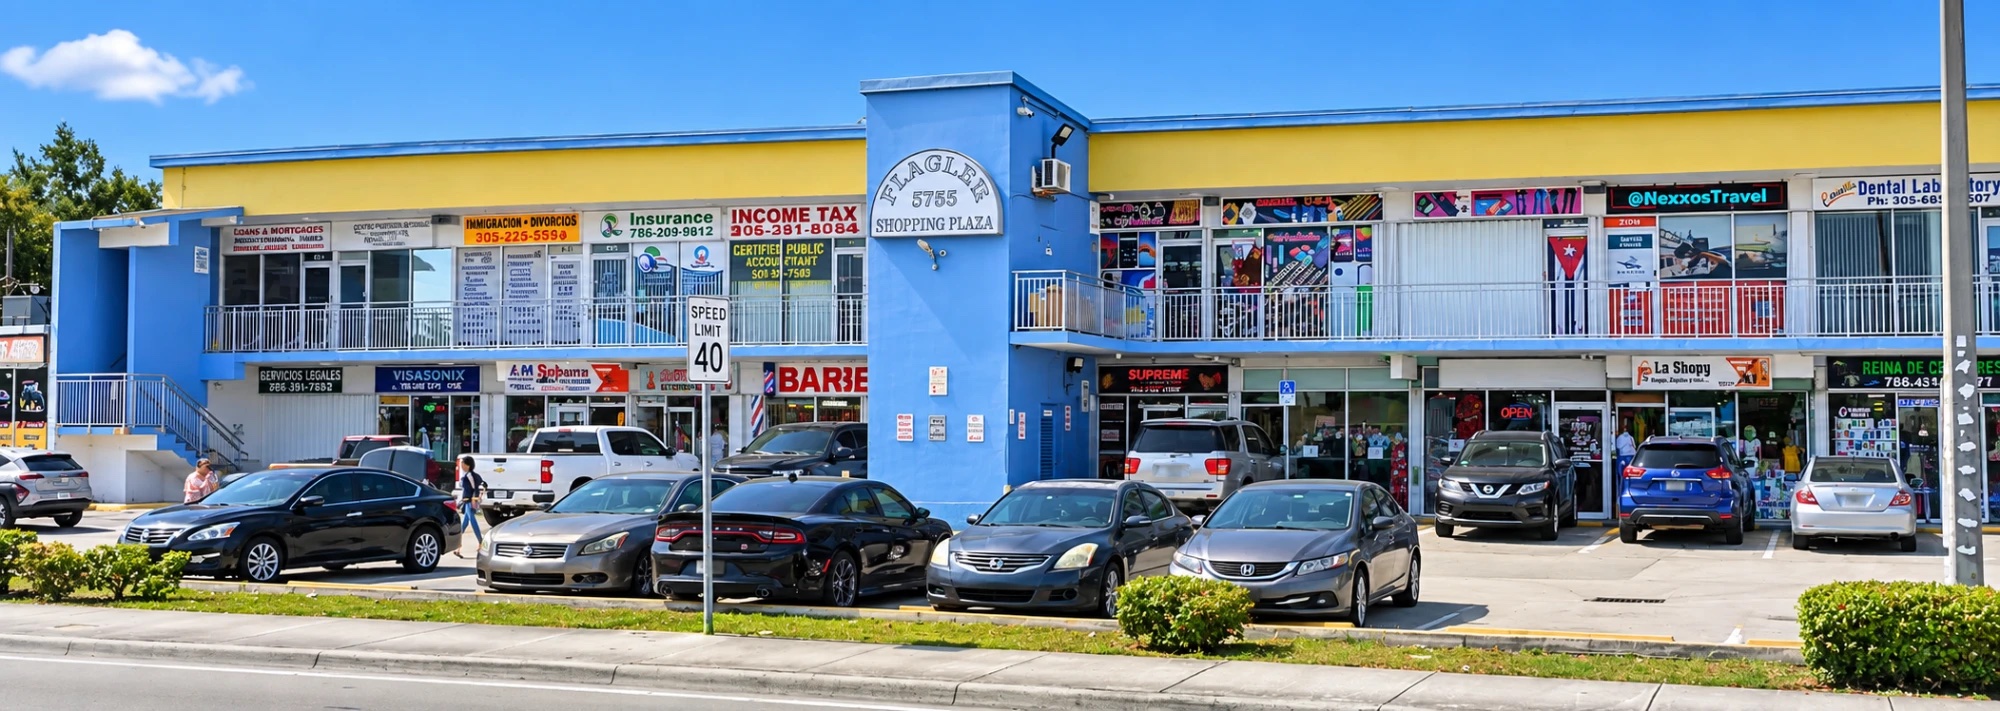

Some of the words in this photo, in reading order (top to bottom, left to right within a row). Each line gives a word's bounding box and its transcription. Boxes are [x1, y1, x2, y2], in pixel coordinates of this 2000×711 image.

[1858, 180, 1906, 196] Dental
[1912, 177, 2000, 195] Labtory
[912, 190, 957, 208] 5755
[1628, 188, 1767, 207] @NexxosTravel
[1867, 196, 1889, 206] Ph:
[630, 212, 713, 226] Insurance
[731, 208, 810, 224] INCOME
[817, 206, 857, 222] TAX
[466, 218, 522, 230] IMMIGRACION
[530, 215, 577, 227] DIVORCIOS
[876, 217, 945, 233] SHOPPING
[949, 215, 993, 230] PLAZA
[630, 226, 713, 238] 786-209-9812
[786, 242, 824, 255] PUBLIC
[691, 305, 727, 321] SPEED
[694, 323, 721, 337] LIMIT
[694, 342, 723, 373] 40
[305, 370, 341, 380] LEGALES
[393, 369, 466, 381] VISASONIX
[1128, 369, 1189, 380] SUPREME
[1654, 361, 1669, 374] La
[1673, 360, 1711, 377] Shopy
[1862, 361, 1902, 375] REINA
[1907, 361, 1925, 375] DE
[1501, 407, 1533, 419] OPEN
